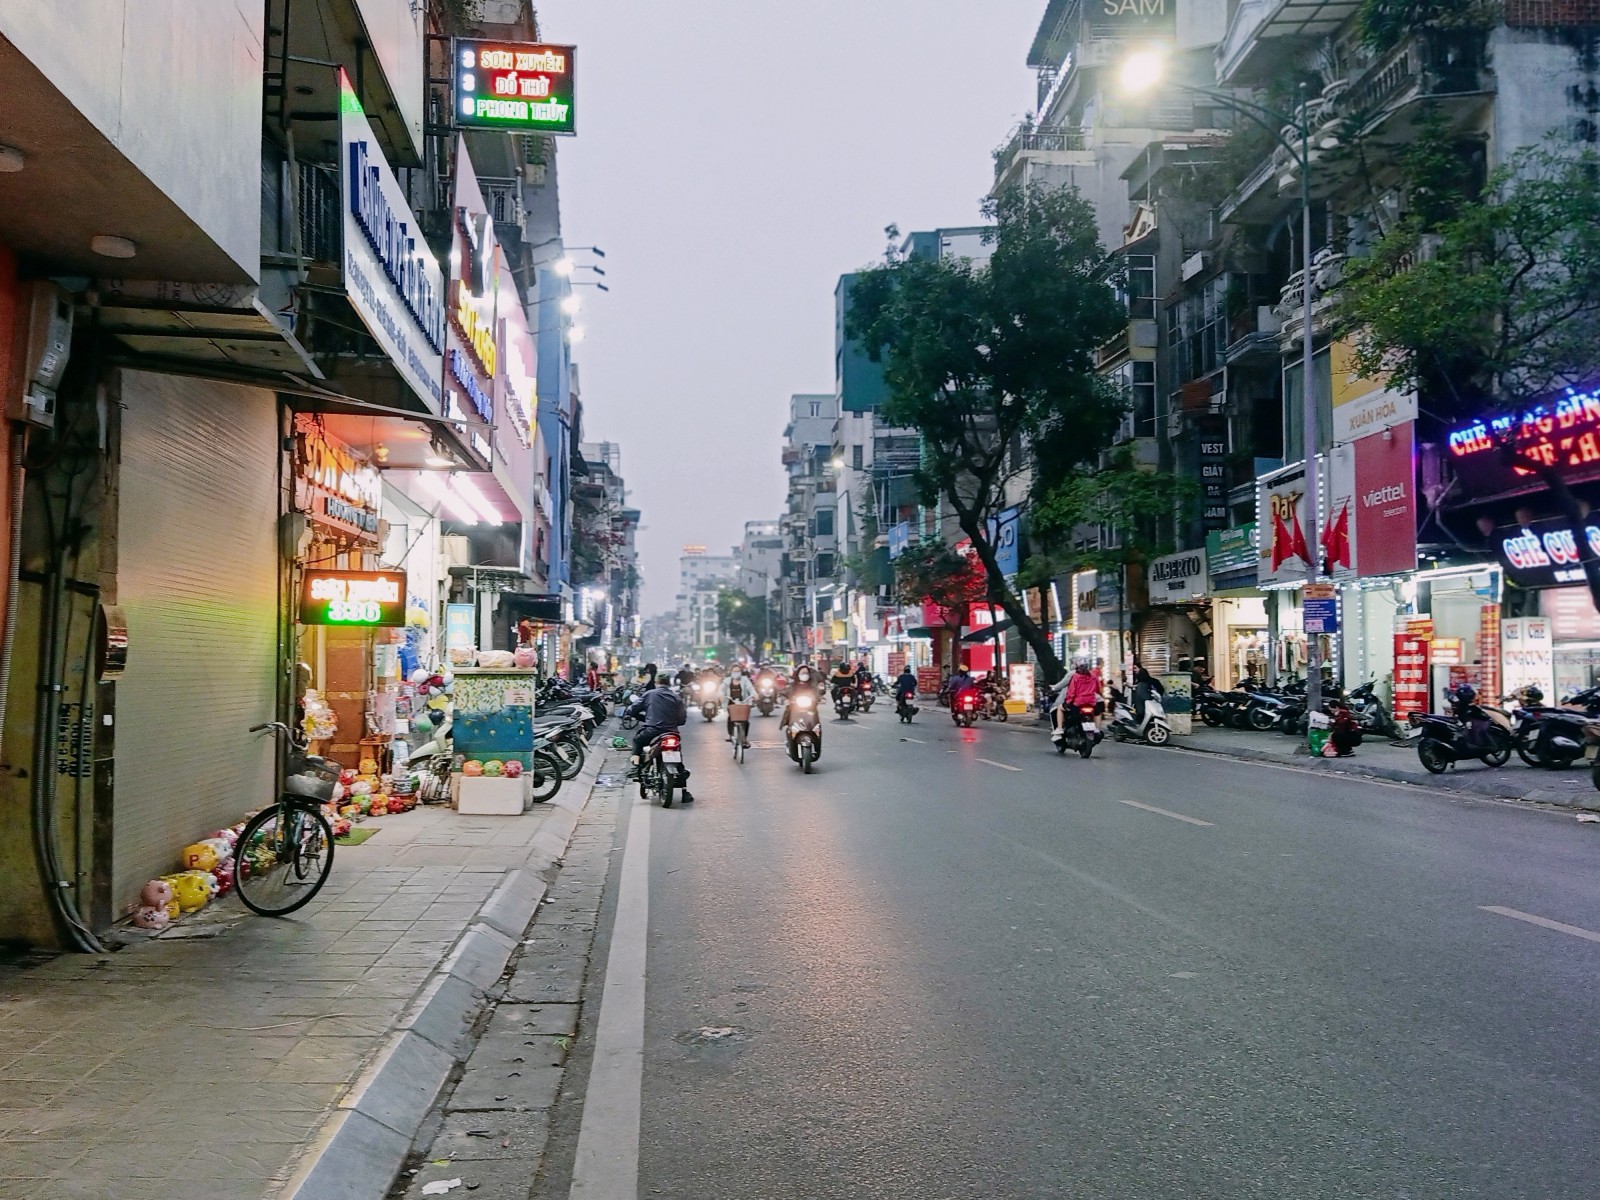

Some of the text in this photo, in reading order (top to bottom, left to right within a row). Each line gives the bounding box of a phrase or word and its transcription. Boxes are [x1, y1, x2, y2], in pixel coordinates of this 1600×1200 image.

[1103, 0, 1164, 16] SAM
[476, 99, 529, 120] PHONG
[1201, 443, 1224, 454] VEST
[1362, 482, 1407, 508] viettel
[1502, 527, 1552, 569] CHÈ
[1152, 555, 1201, 581] ALBERTO
